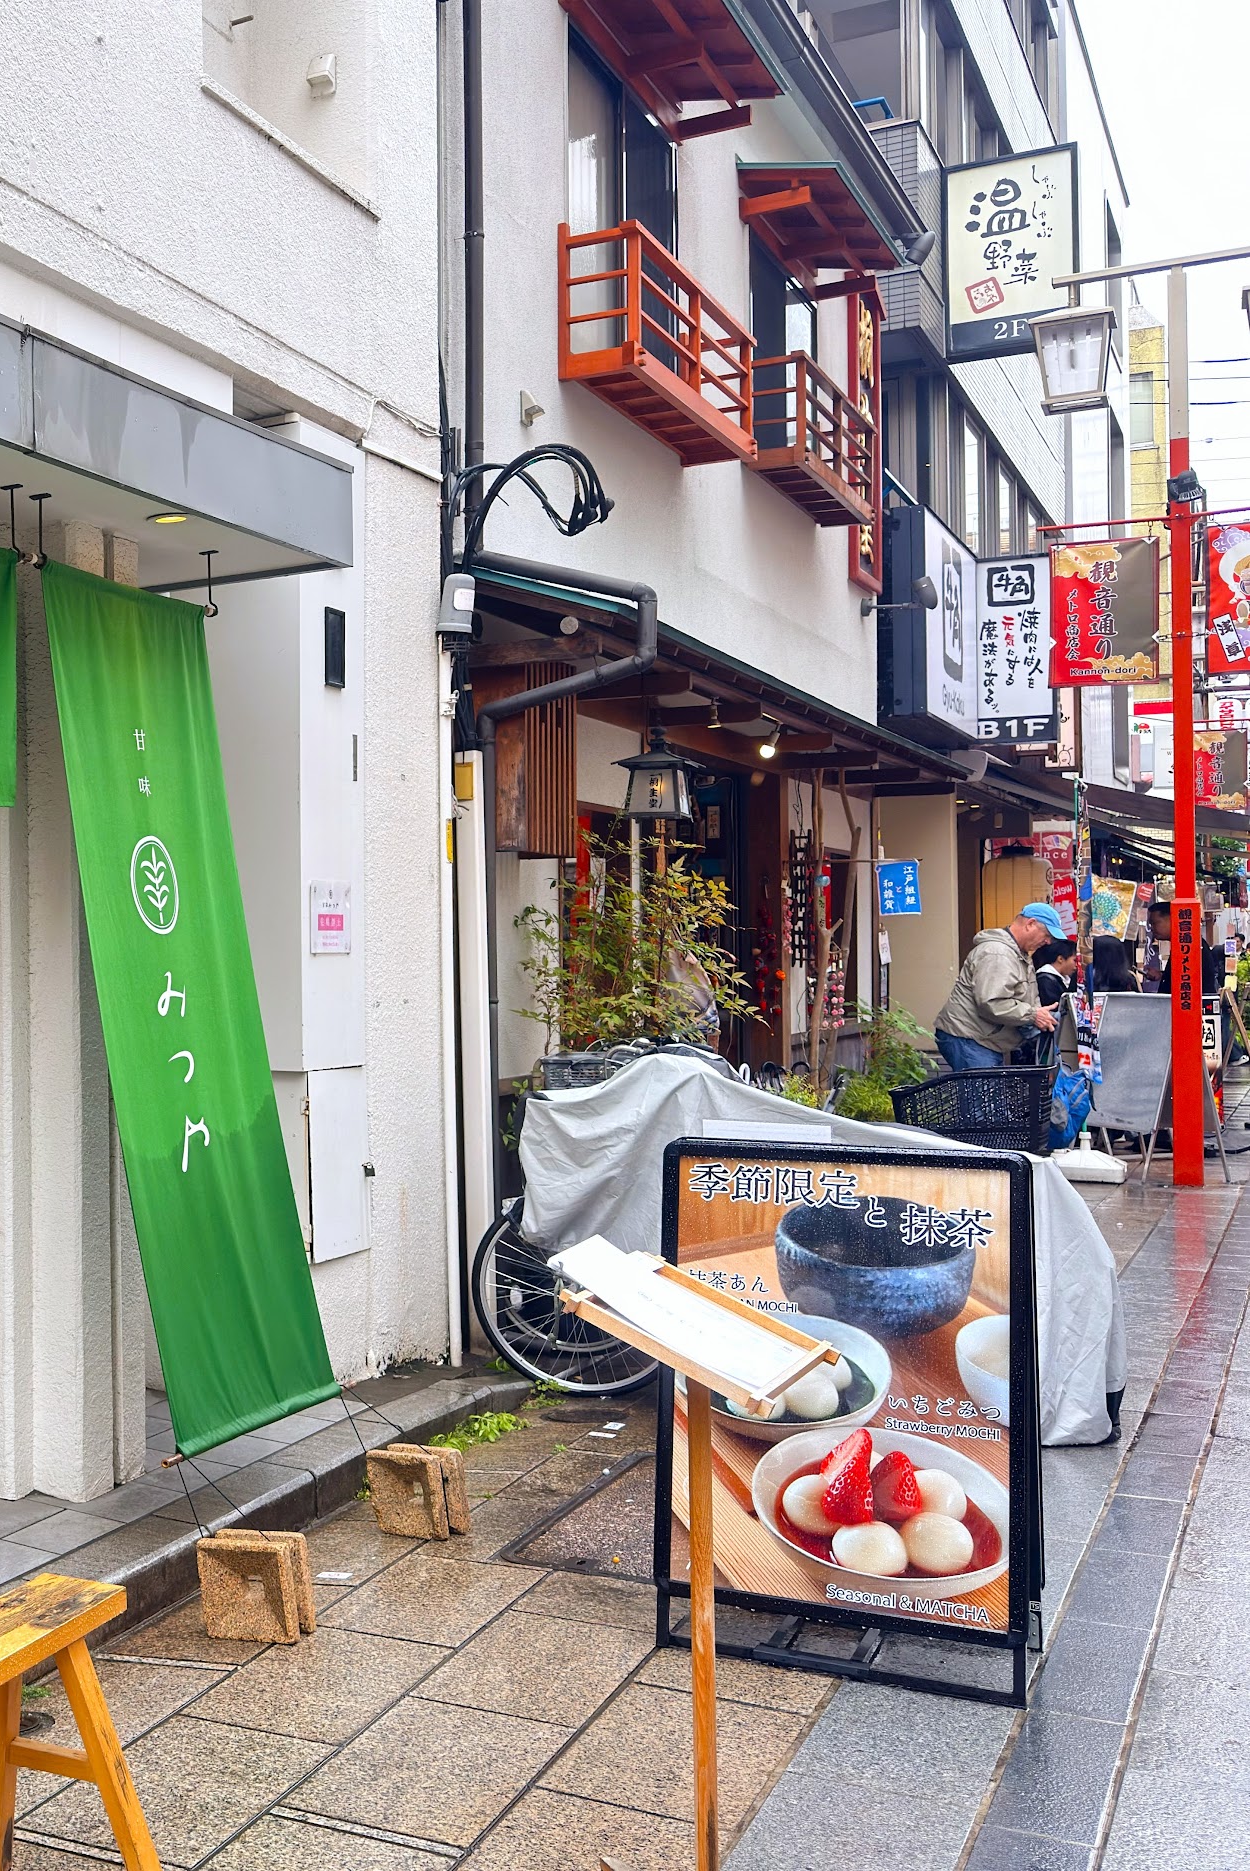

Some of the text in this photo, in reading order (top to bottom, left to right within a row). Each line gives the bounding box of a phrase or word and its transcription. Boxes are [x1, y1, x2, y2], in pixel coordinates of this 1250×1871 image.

[1031, 164, 1057, 238] しゃぶしゃぶ
[993, 319, 1029, 340] 2F
[993, 573, 1030, 597] 牛角
[1065, 588, 1081, 661] メトロ商店会
[1088, 560, 1119, 661] 観音通り
[1001, 615, 1021, 687] 元気にする
[1017, 606, 1044, 689] 焼肉には人を
[1216, 618, 1243, 658] 浅草
[1069, 663, 1138, 677] Kannon-dori
[978, 718, 1050, 741] B1F
[131, 730, 151, 798] 甘味
[895, 885, 903, 893] と
[155, 970, 212, 1174] みつや
[756, 1301, 799, 1313] MOCHI
[886, 1417, 1001, 1441] Strawberry MOCHI
[826, 1584, 990, 1623] Seasonal & MATCHA
